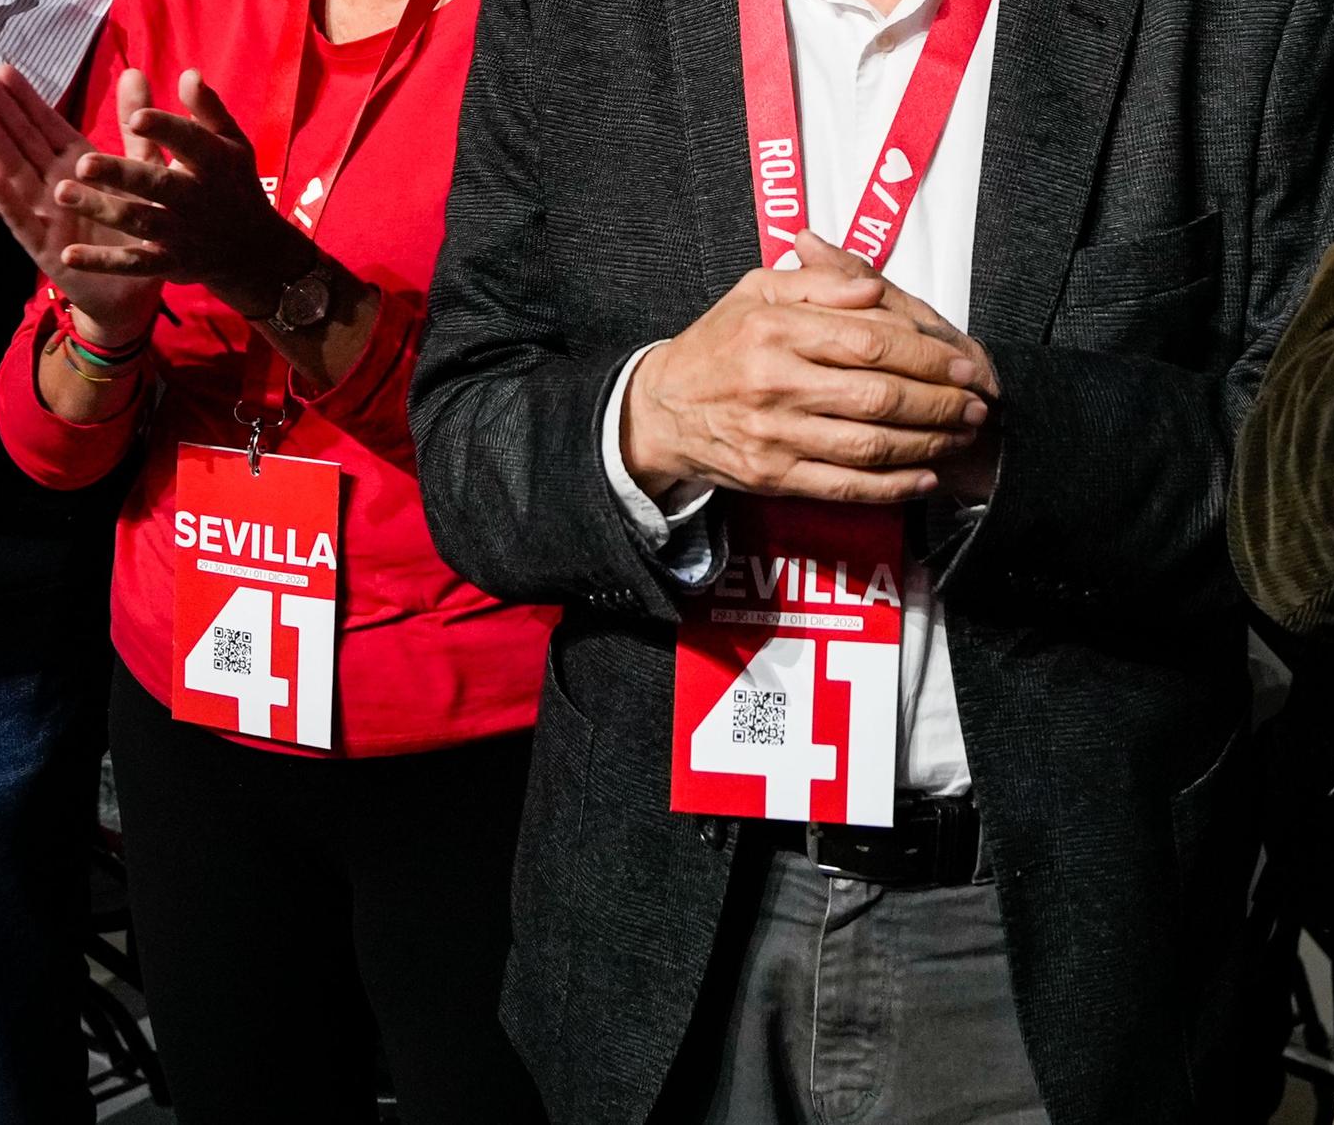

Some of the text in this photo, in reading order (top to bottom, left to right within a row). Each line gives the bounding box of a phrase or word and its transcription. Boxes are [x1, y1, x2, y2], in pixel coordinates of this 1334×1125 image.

[758, 138, 800, 218] ROJO
[846, 215, 892, 267] JA
[175, 510, 337, 571] SEVILLA
[199, 560, 208, 570] 29
[214, 562, 224, 572] 30
[229, 565, 249, 576] NOV
[268, 572, 284, 582] DIC
[285, 574, 306, 585] 2024
[681, 556, 902, 607] EVILLA
[810, 615, 829, 626] DIC
[833, 617, 860, 628] 2024
[183, 586, 336, 749] 41
[690, 637, 900, 828] 41
